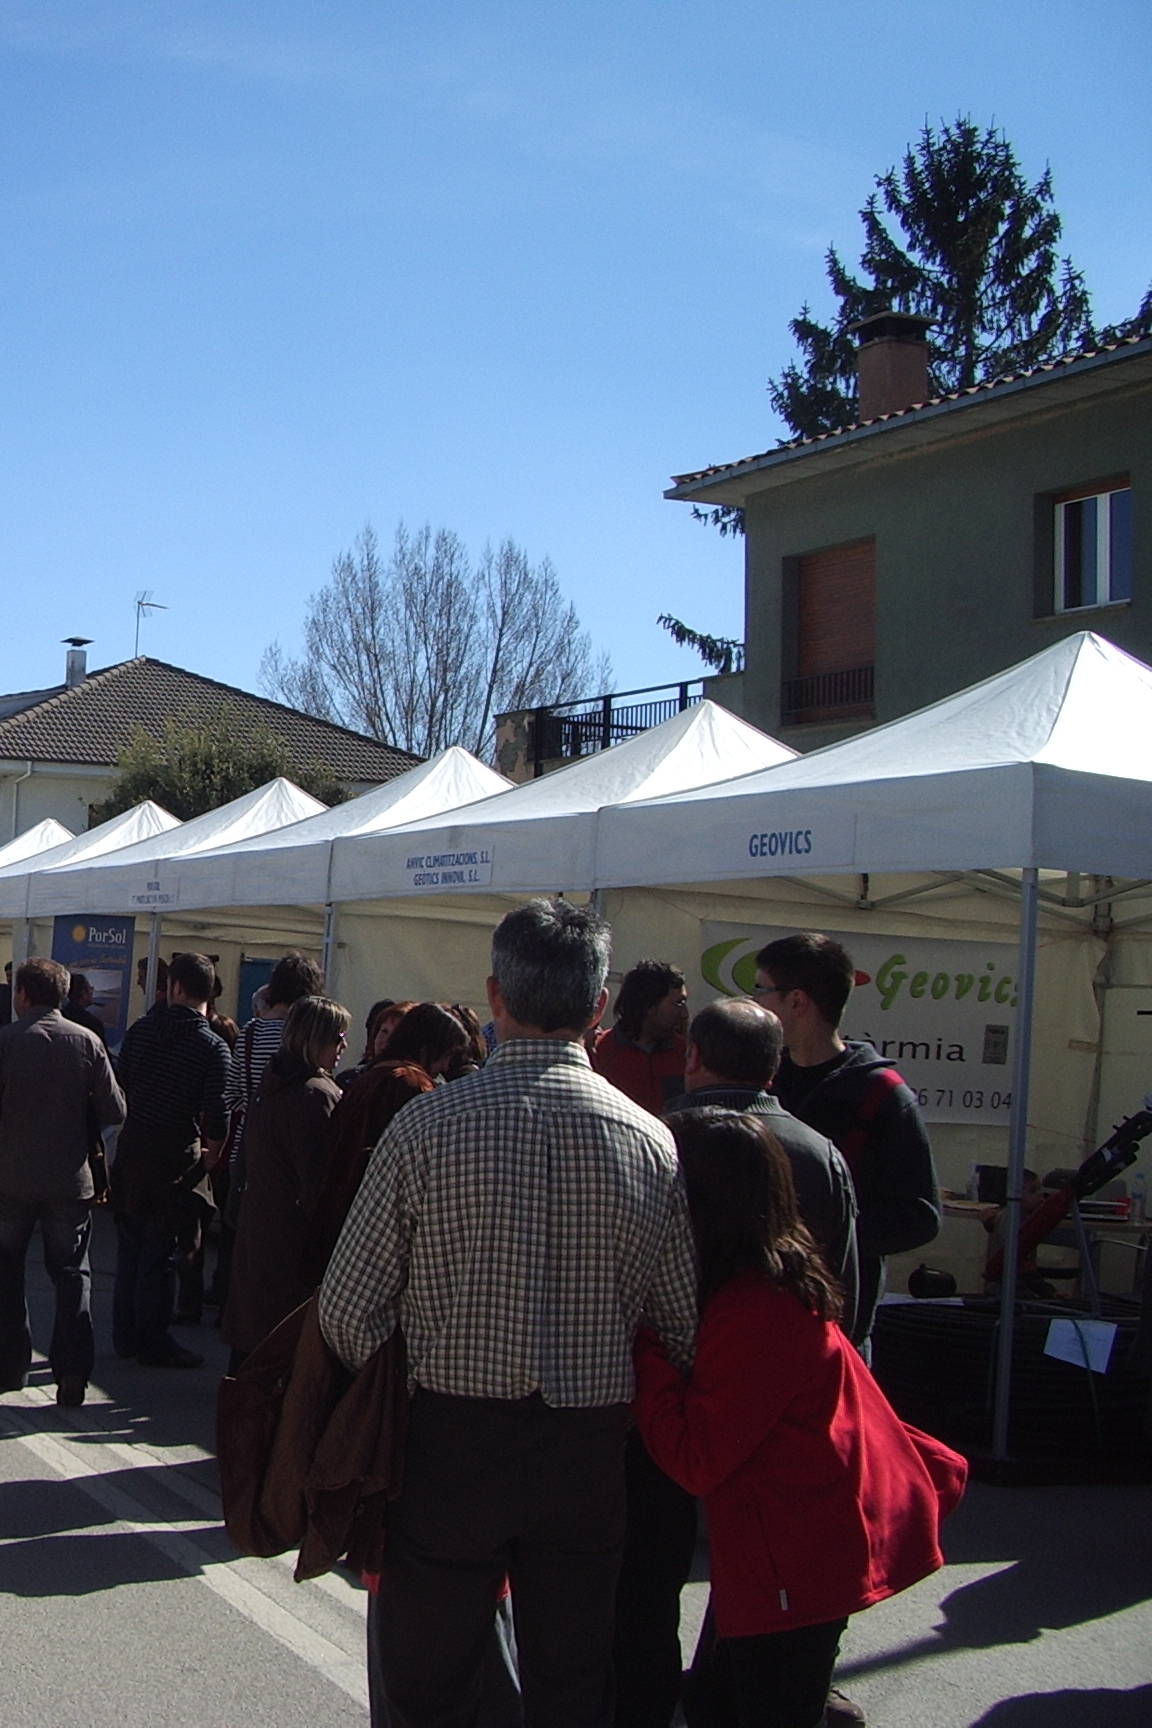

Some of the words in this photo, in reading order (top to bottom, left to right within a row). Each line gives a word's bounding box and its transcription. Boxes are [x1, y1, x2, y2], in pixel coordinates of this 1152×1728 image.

[748, 829, 812, 858] GEOVICS
[88, 926, 127, 945] PorSol
[935, 1089, 954, 1108] 71
[962, 1090, 984, 1109] 03
[990, 1091, 1013, 1110] 04
